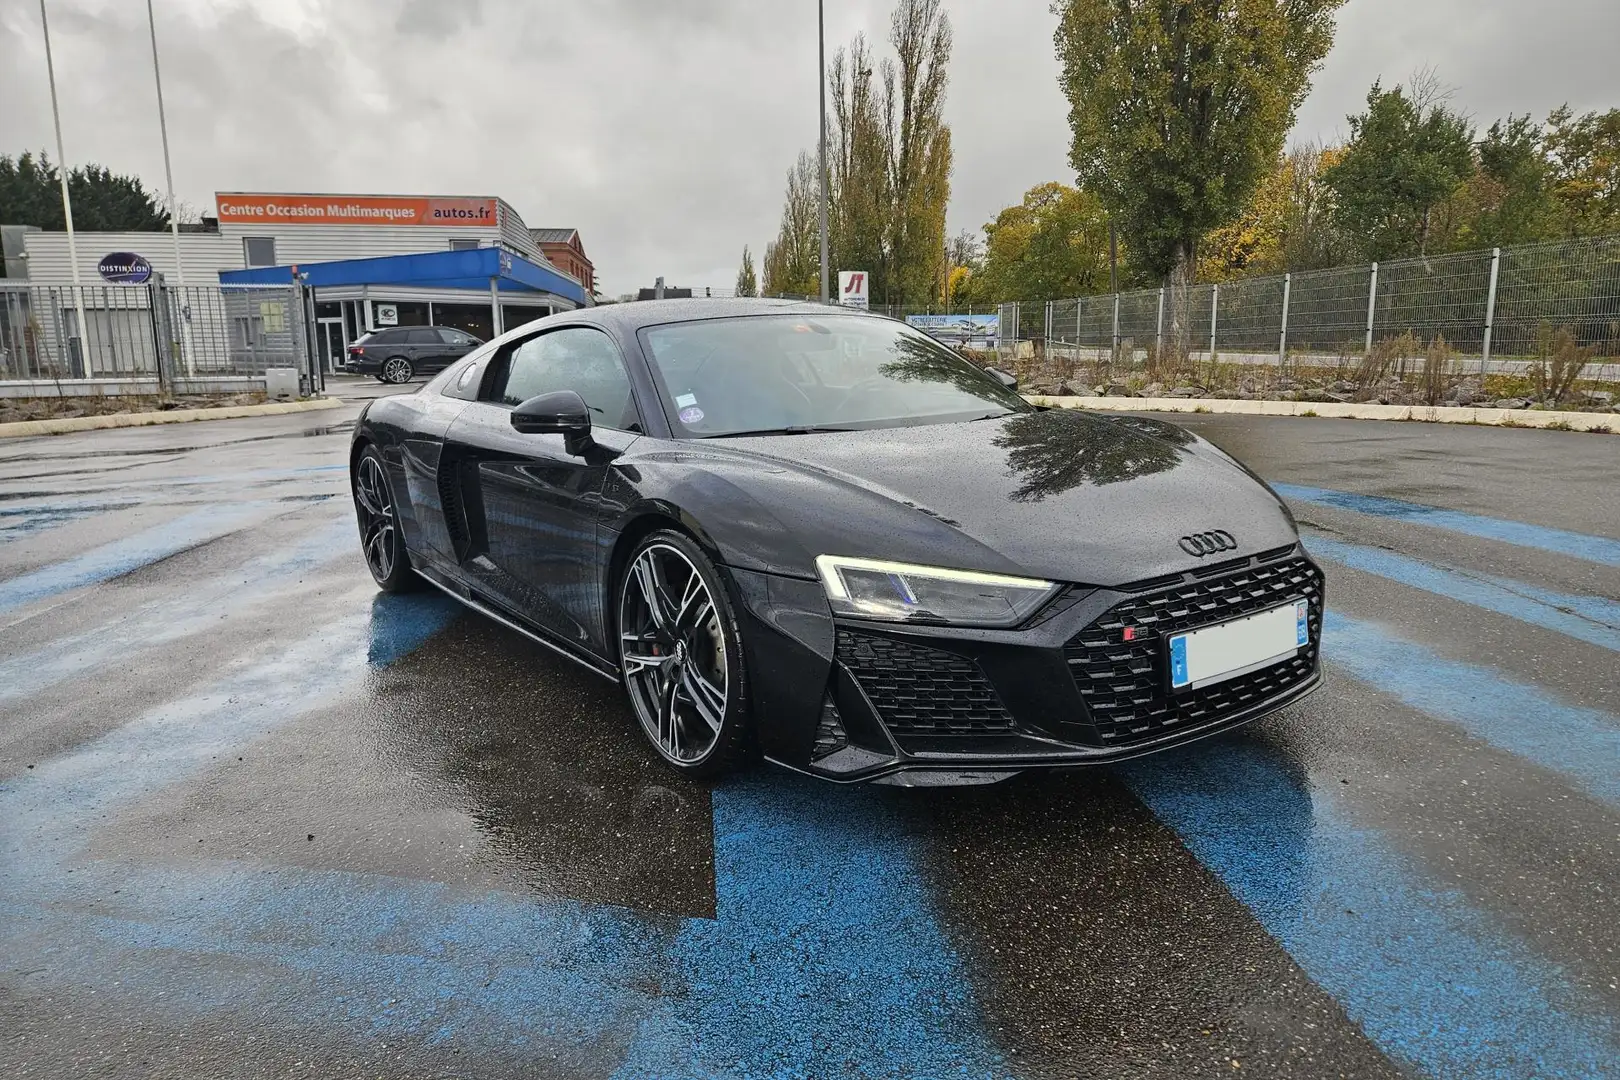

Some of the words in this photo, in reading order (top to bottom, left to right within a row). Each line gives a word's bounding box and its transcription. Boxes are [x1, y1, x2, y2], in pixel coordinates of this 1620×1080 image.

[220, 203, 264, 216] Centre
[266, 203, 324, 217] Occasion
[327, 204, 415, 220] Multimarques
[434, 206, 490, 218] autos.fr
[100, 265, 148, 273] DISTINXION
